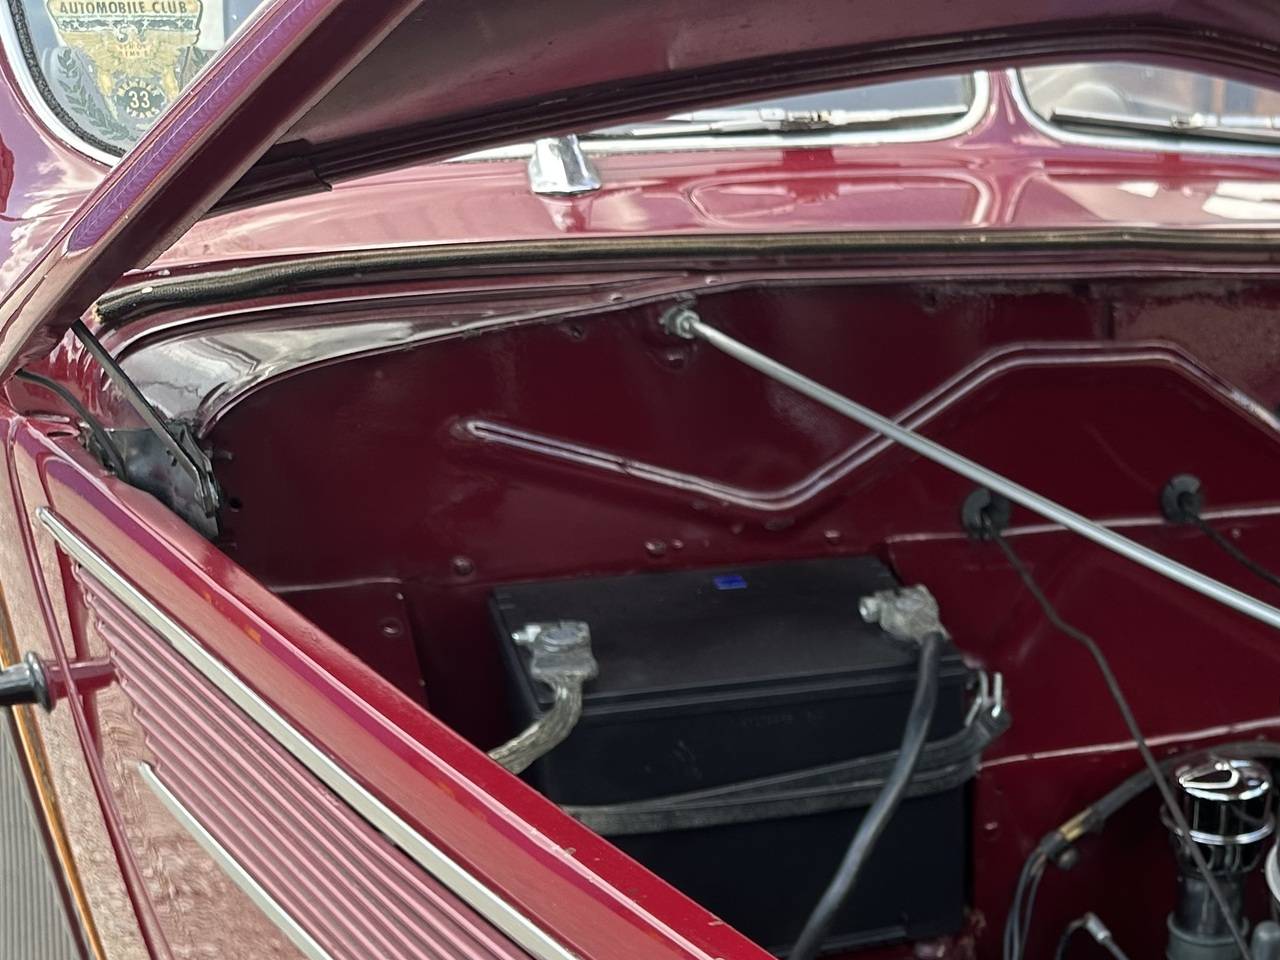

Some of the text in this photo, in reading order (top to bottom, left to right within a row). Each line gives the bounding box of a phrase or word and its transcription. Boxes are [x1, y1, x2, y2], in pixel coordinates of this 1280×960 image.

[60, 1, 188, 15] AUTOMOBILE CLUB
[128, 90, 151, 109] 33
